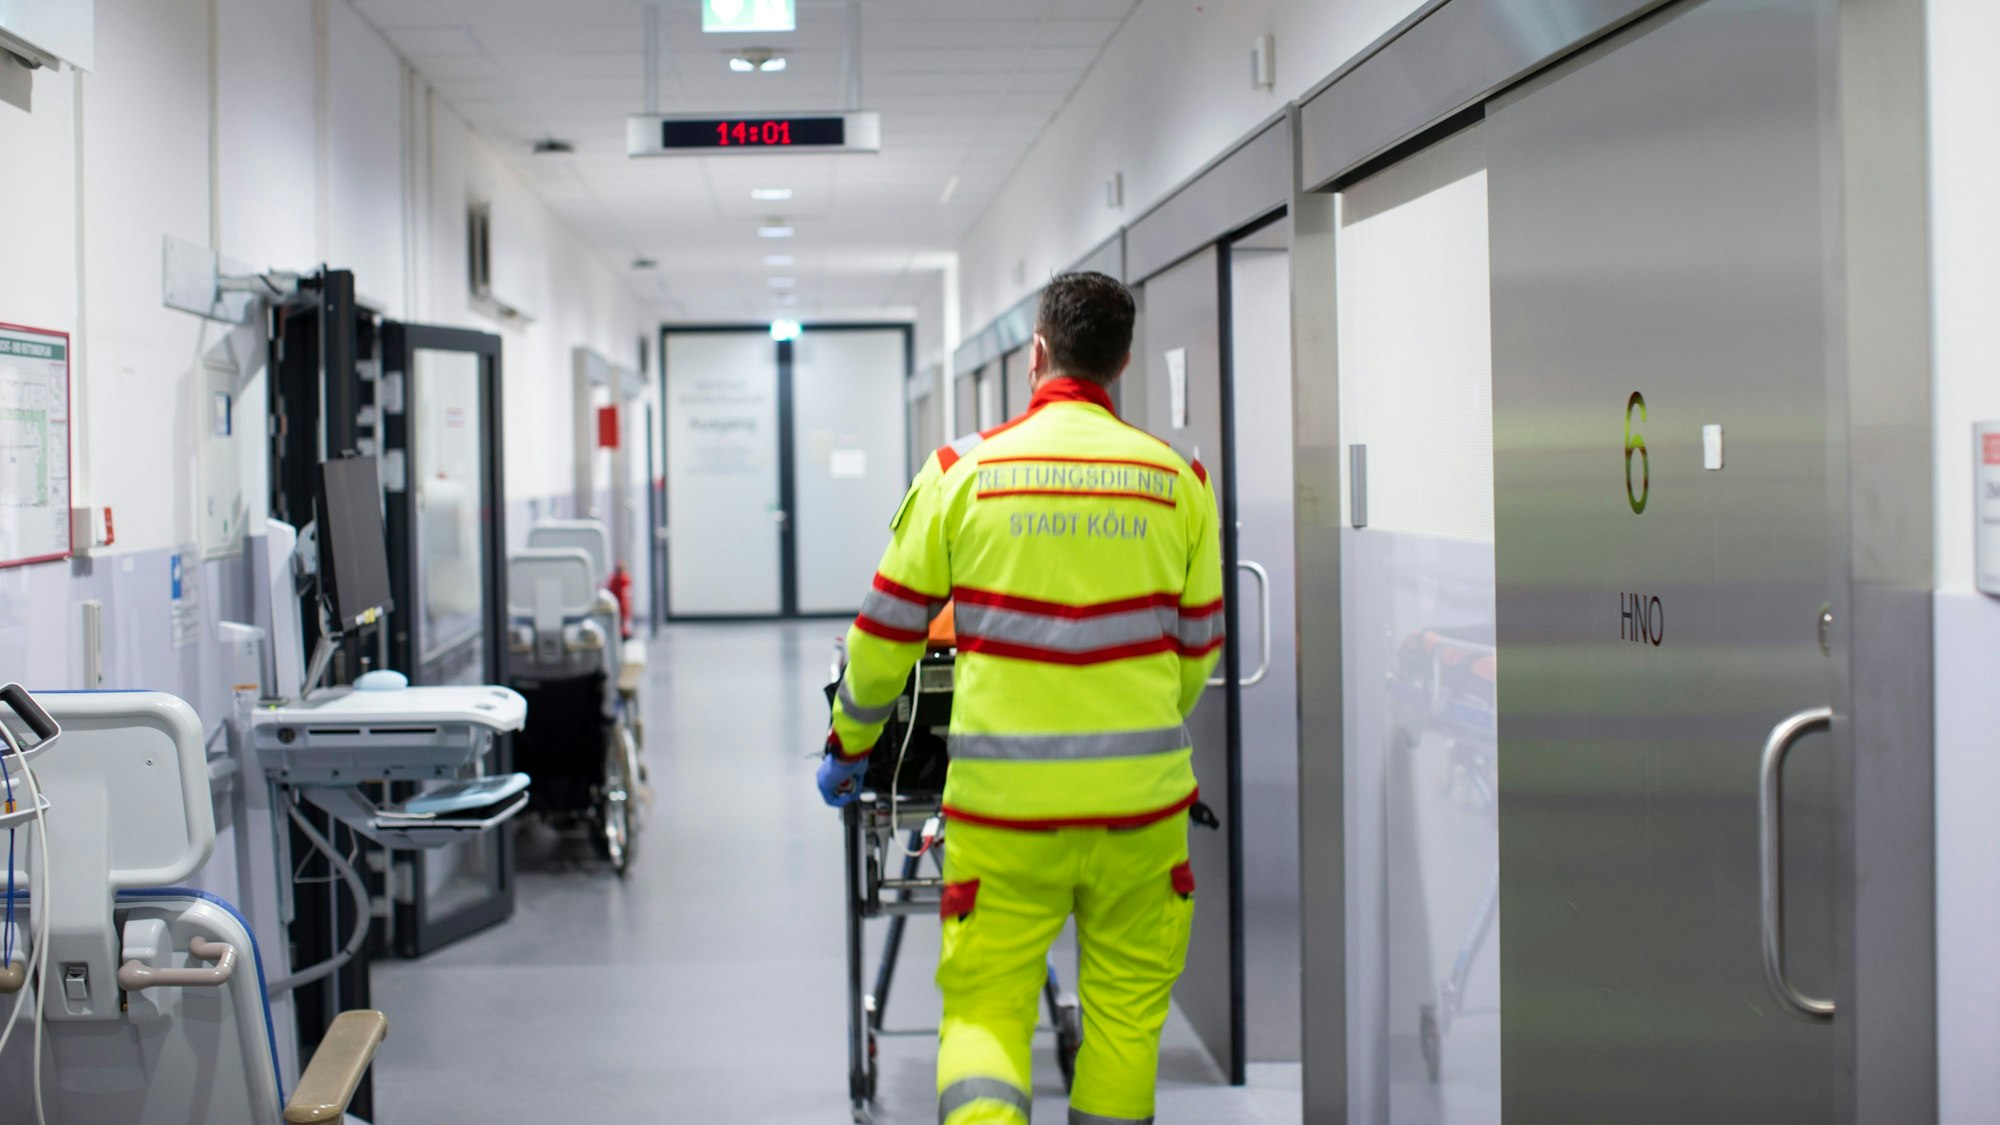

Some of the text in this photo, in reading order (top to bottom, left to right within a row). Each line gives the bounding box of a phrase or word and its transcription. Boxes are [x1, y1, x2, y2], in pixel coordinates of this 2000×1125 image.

[716, 121, 791, 145] 14:01
[1624, 391, 1649, 514] 6
[977, 466, 1177, 499] RETTUNGSDIENST
[1009, 509, 1147, 540] STADT KÖLN
[1621, 592, 1663, 646] HNO
